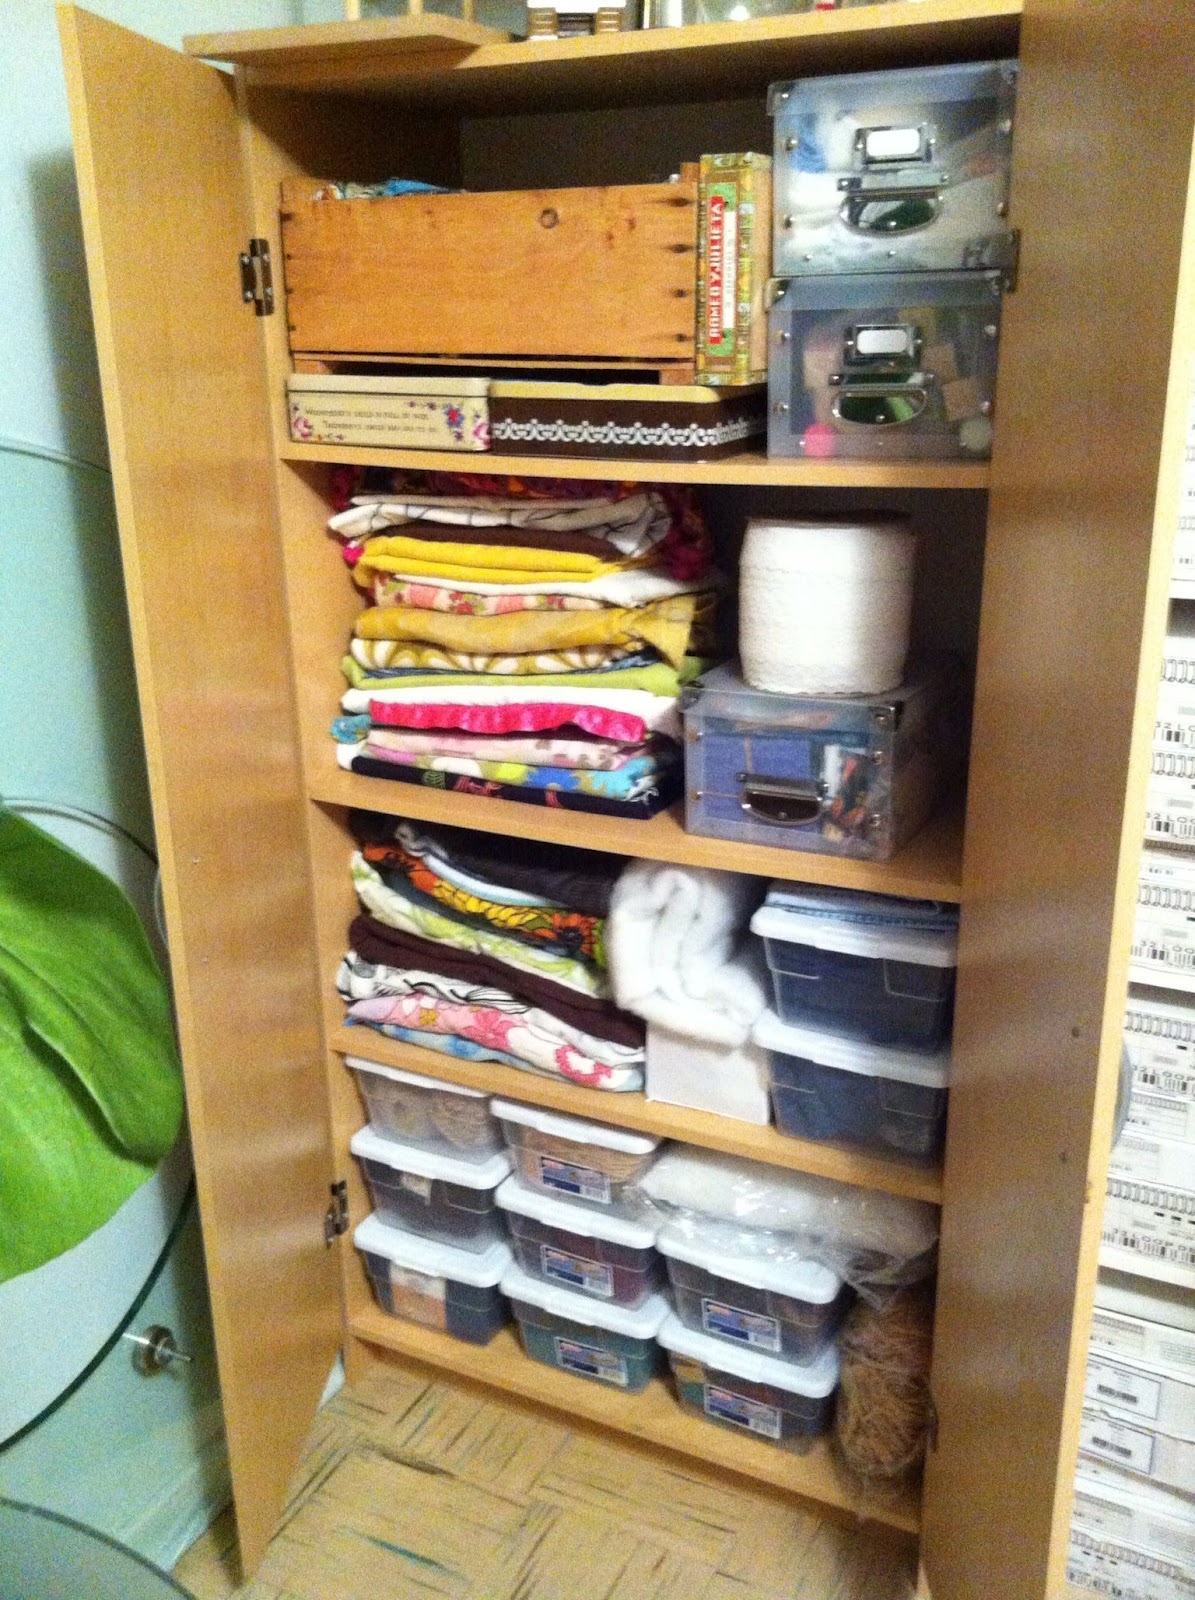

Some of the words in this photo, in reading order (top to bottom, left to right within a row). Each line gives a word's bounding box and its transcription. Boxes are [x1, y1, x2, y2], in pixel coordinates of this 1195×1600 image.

[710, 203, 722, 272] JULIETA
[709, 271, 721, 282] Y
[709, 286, 721, 338] ROMEO
